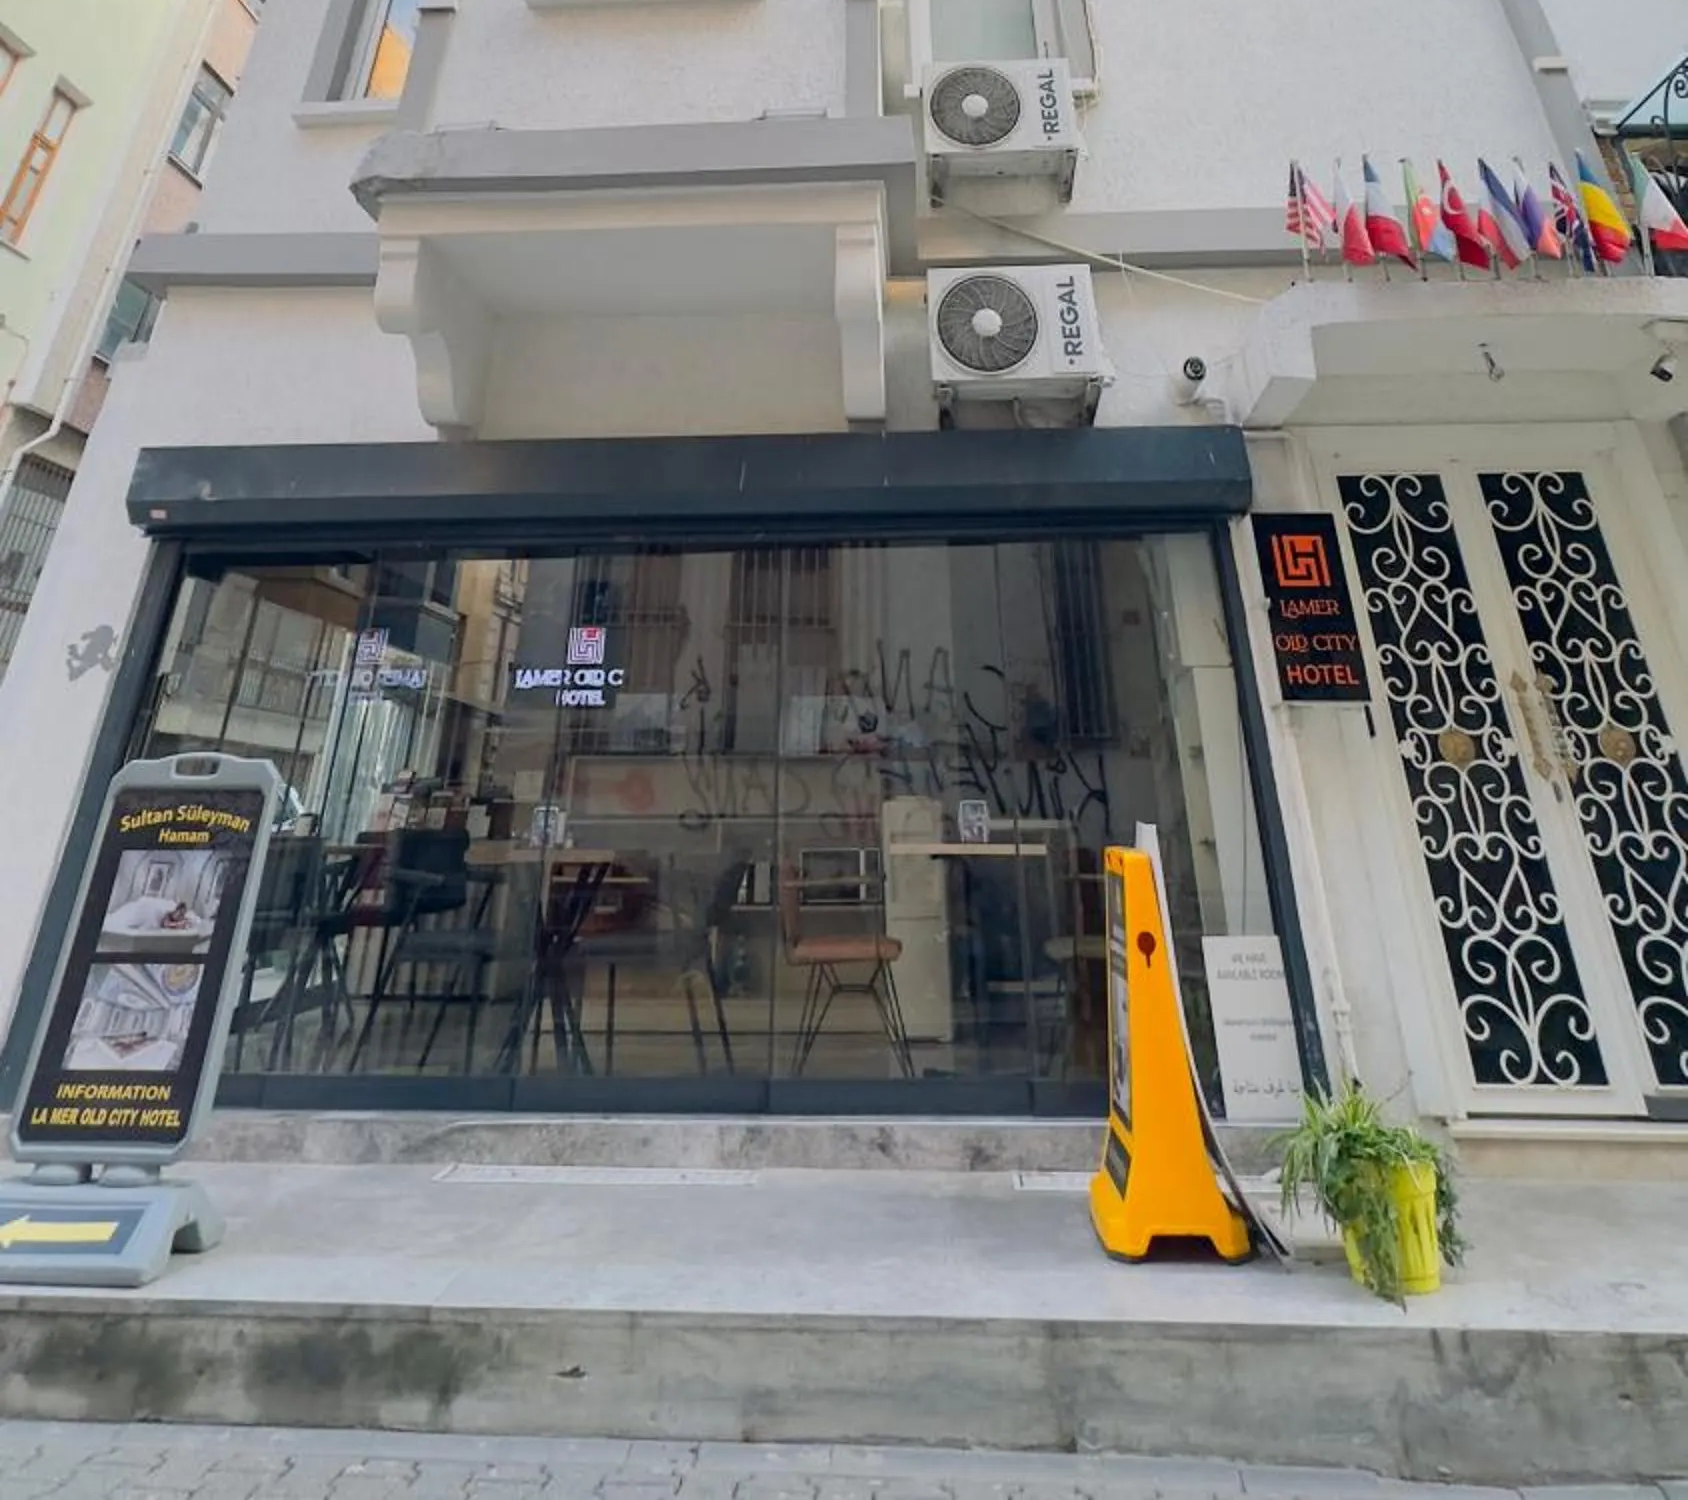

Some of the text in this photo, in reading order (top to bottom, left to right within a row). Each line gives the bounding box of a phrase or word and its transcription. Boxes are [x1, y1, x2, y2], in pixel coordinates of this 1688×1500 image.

[1037, 67, 1060, 134] REGAL
[1056, 275, 1083, 357] REGAL
[1276, 633, 1356, 653] OLD CITY
[1286, 664, 1360, 686] HOTEL
[120, 804, 250, 833] Sultan Süleyman
[158, 828, 209, 843] Hamam
[56, 1083, 171, 1100] INFORMATION
[31, 1107, 181, 1127] LA MER OLD CITY HOTEL
